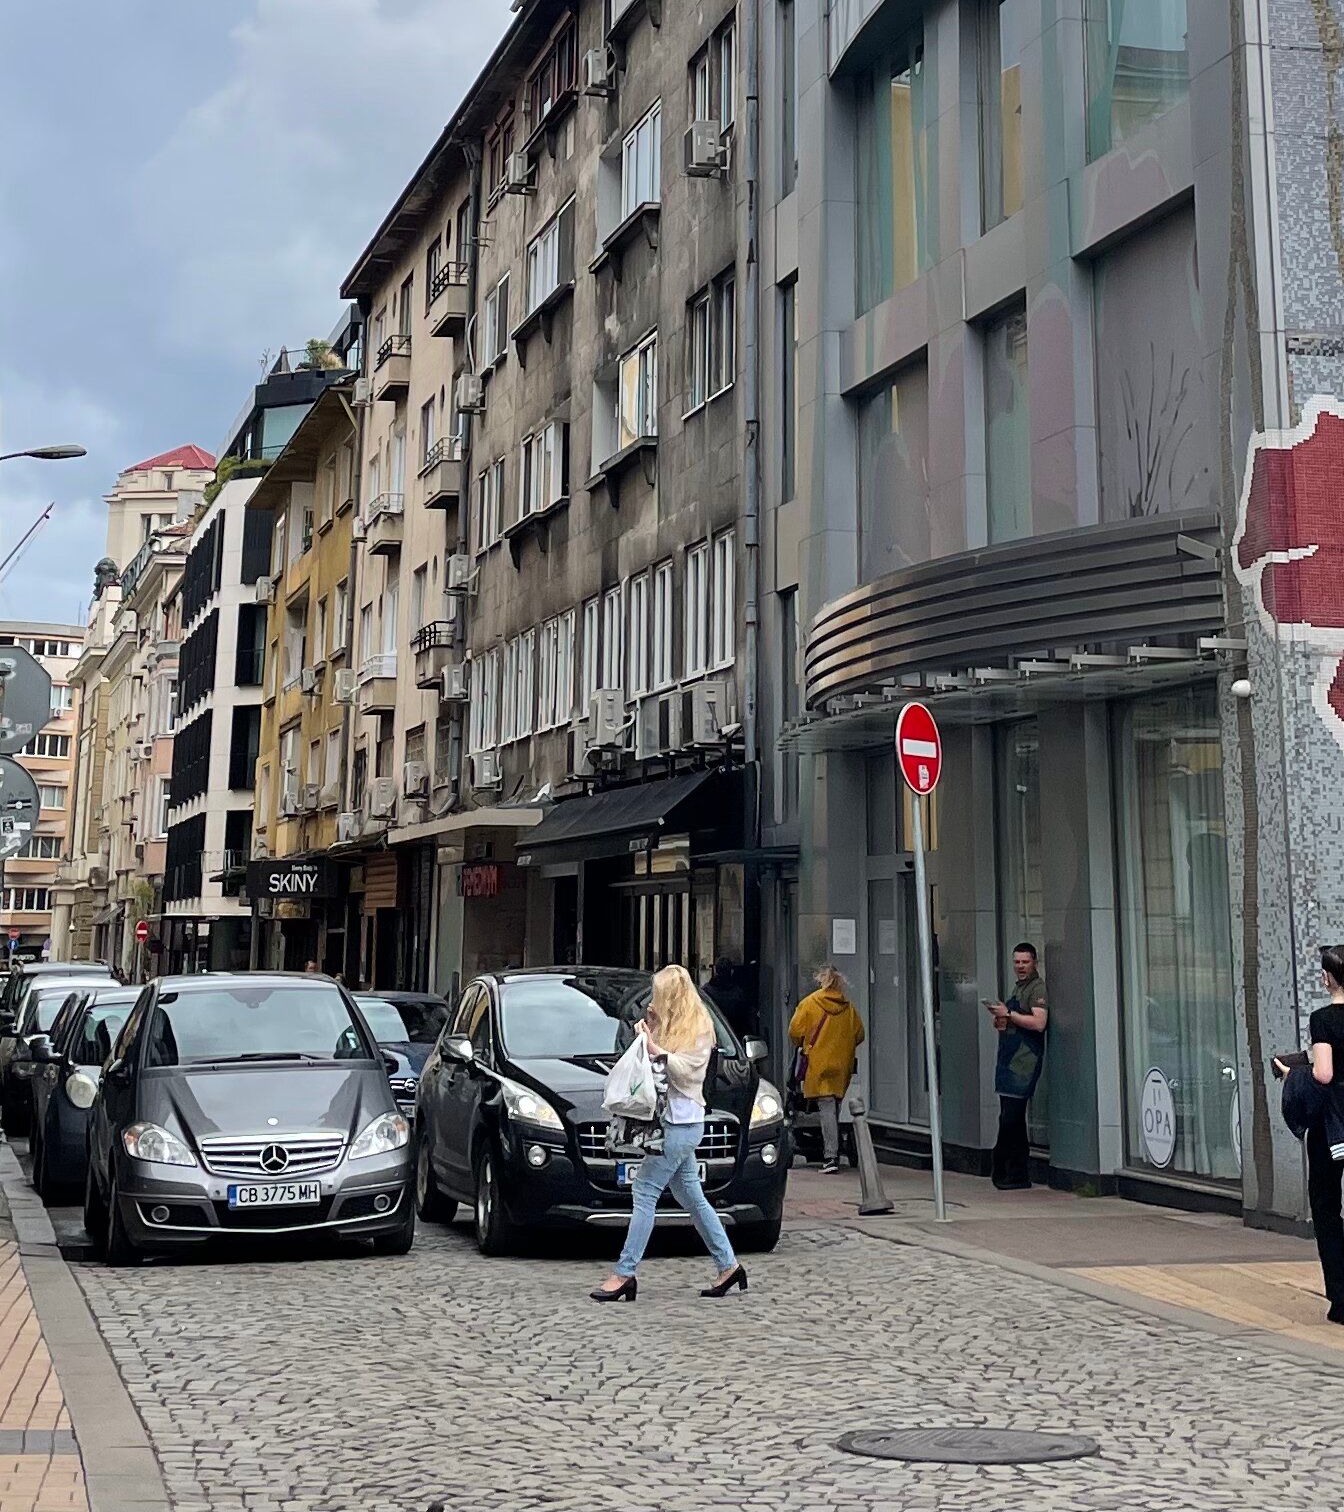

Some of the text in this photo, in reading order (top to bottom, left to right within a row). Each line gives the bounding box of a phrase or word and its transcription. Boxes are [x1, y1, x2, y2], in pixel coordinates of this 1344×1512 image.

[268, 873, 319, 893] SKINY
[1144, 1108, 1172, 1137] OPA
[238, 1187, 258, 1204] CB
[261, 1185, 297, 1202] 3775
